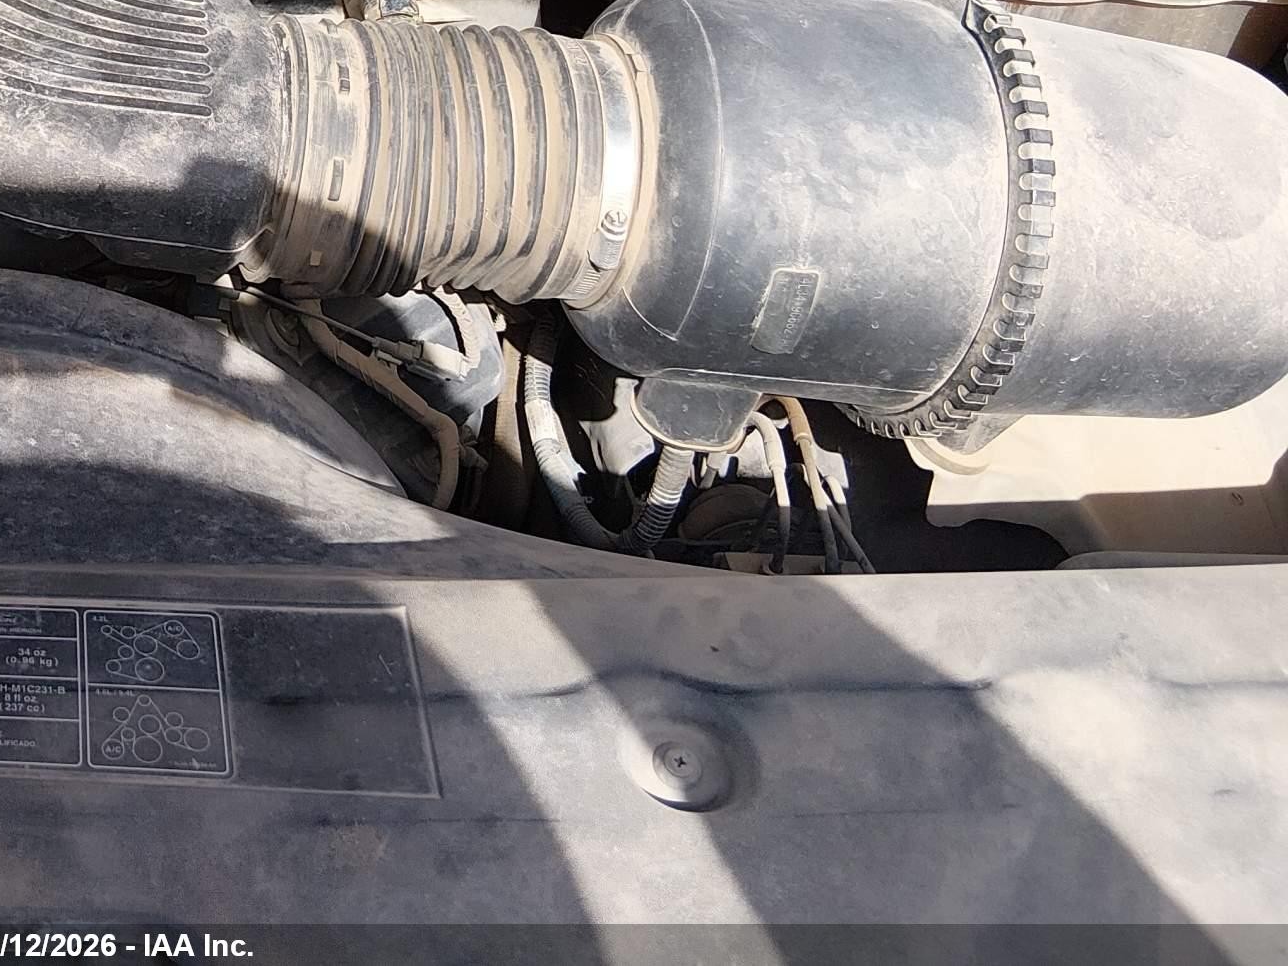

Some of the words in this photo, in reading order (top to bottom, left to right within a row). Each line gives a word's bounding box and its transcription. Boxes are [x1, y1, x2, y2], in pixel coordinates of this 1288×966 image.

[92, 614, 109, 623] 4.2L
[167, 624, 181, 632] A/C
[17, 647, 31, 657] 34
[33, 649, 47, 657] oz
[4, 693, 11, 702] 8
[23, 695, 37, 704] oz
[105, 745, 121, 753] A/C
